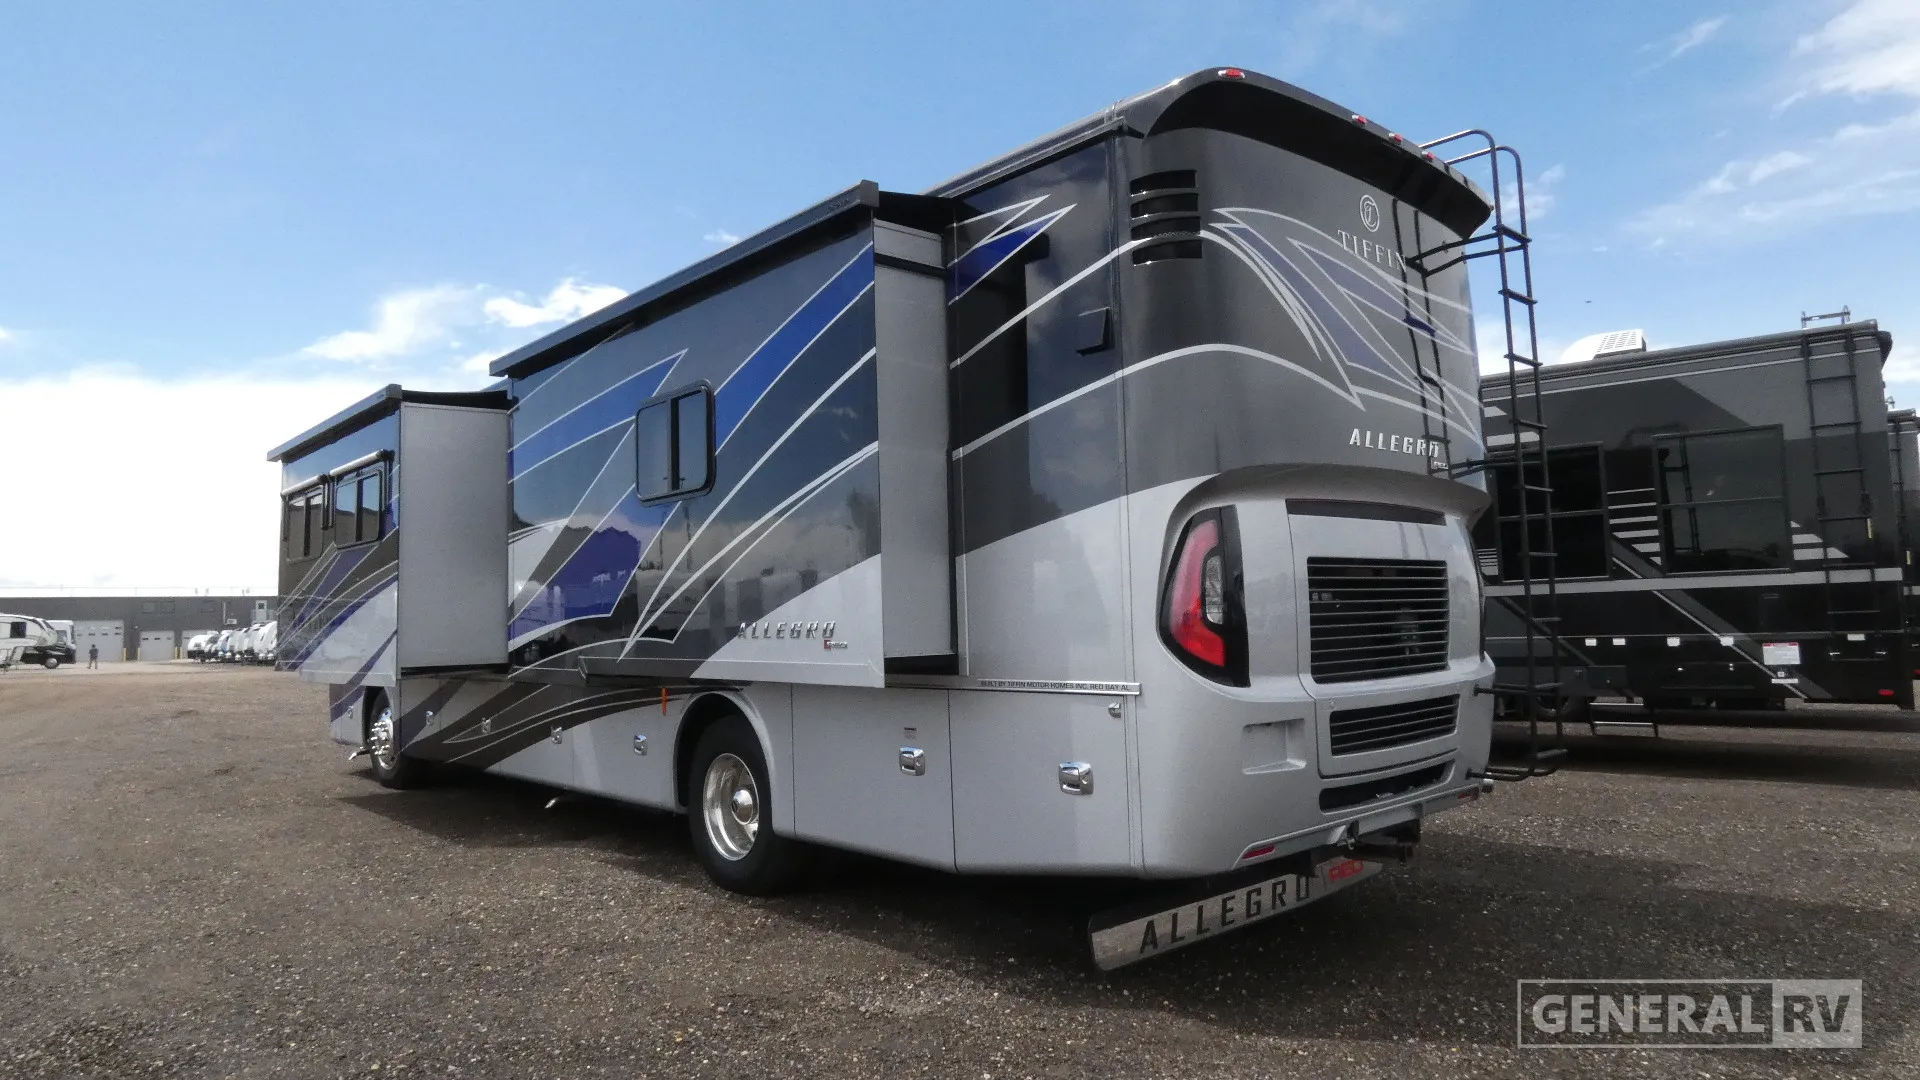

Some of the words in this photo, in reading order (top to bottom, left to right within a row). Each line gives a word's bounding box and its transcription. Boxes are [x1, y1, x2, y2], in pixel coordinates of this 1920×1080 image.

[1338, 230, 1406, 272] TIFFIN
[738, 620, 835, 639] ALLEGRO
[1140, 875, 1310, 954] ALLEGRO
